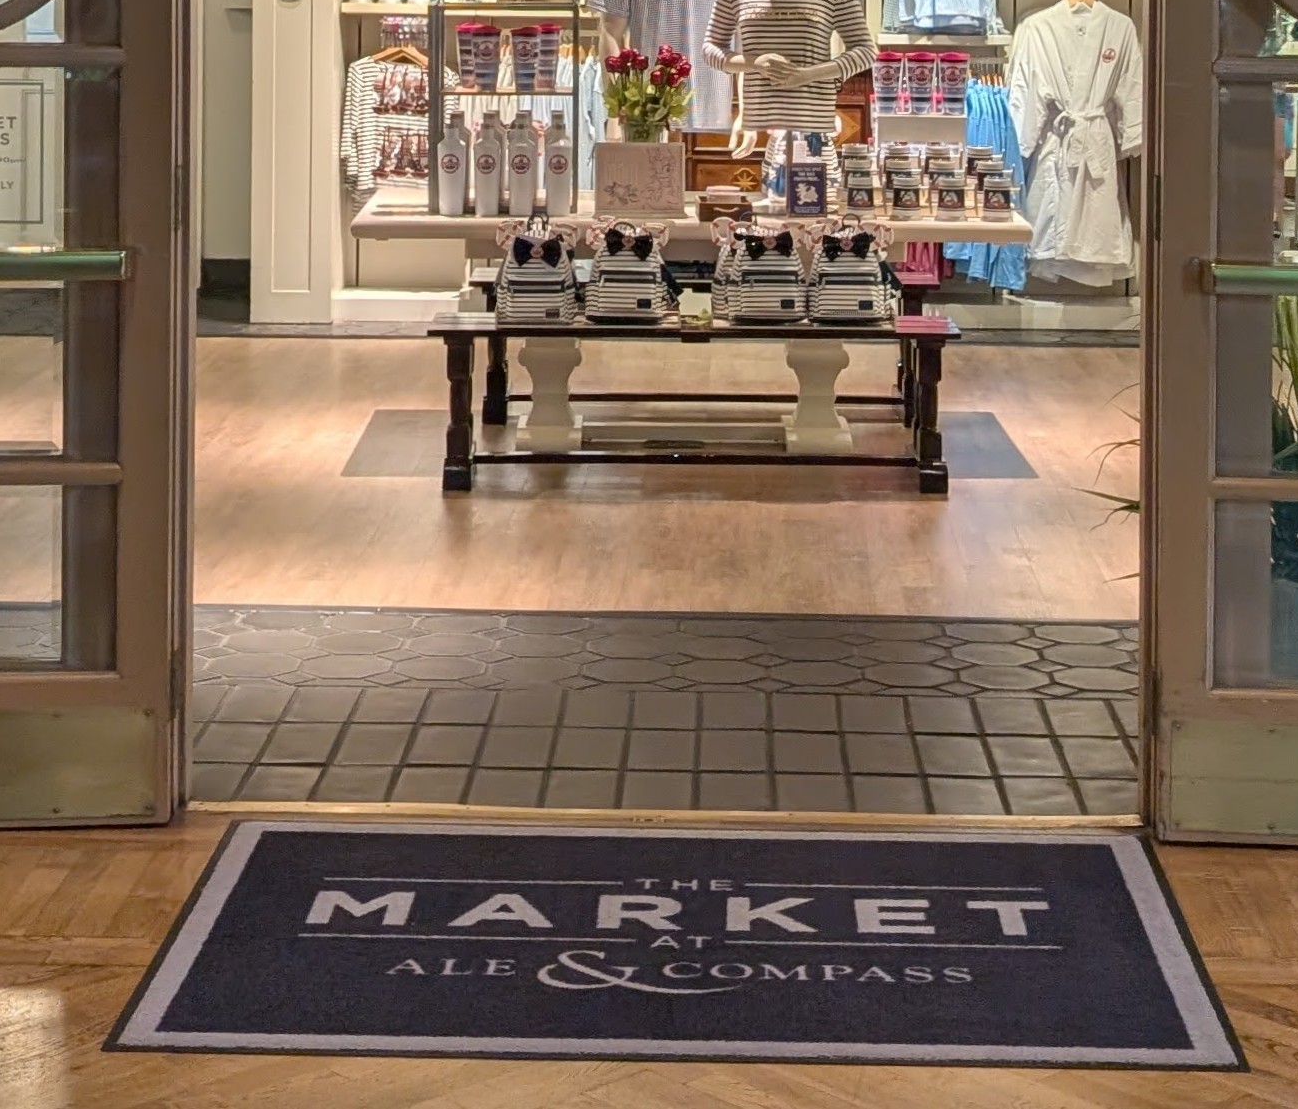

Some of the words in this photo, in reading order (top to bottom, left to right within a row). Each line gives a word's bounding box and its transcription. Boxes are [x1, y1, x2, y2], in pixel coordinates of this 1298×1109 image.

[634, 877, 735, 893] THE
[303, 889, 1052, 938] MARKET
[648, 935, 710, 951] AT
[385, 957, 516, 977] ALE
[536, 949, 745, 994] &
[660, 961, 976, 984] COMPASS
